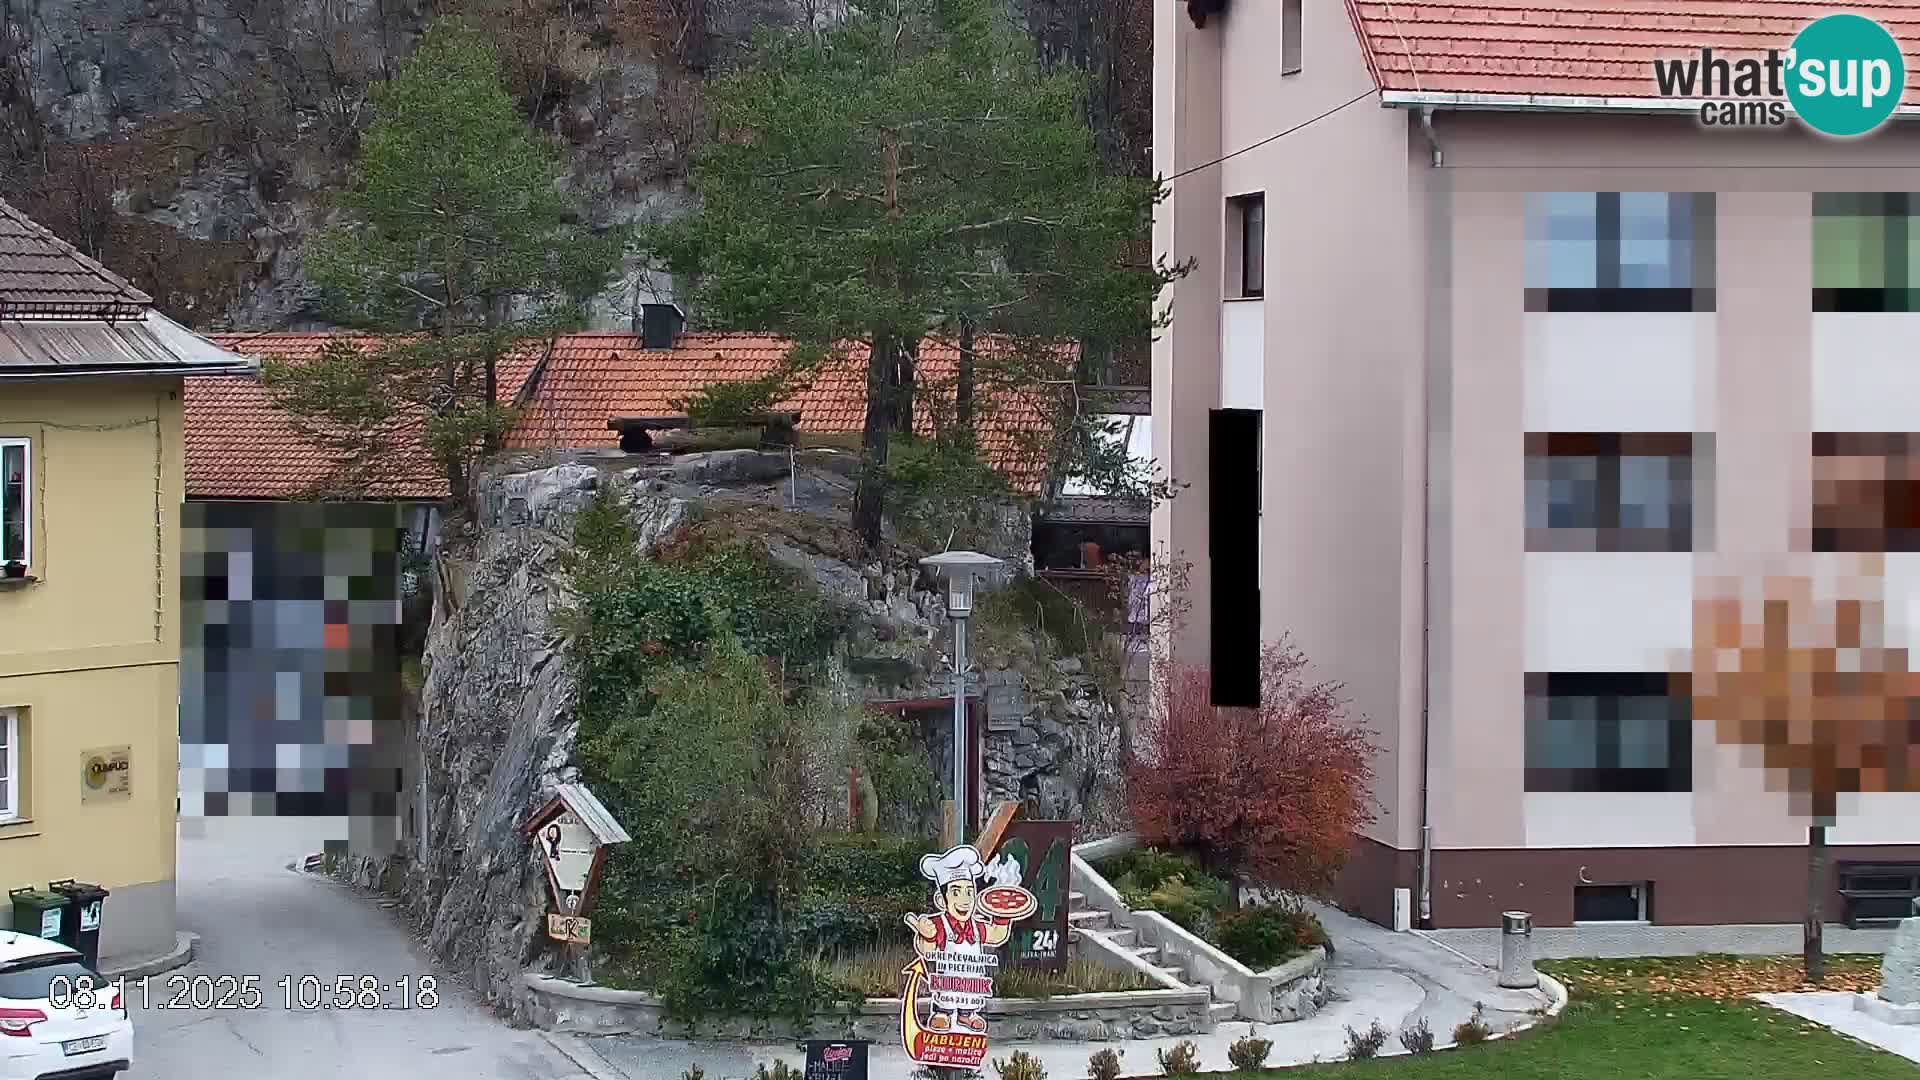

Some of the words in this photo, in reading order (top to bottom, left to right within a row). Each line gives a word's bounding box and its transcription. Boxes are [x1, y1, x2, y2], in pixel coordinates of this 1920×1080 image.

[925, 952, 997, 964] OKREPČEVALNICA
[937, 962, 947, 971] IN
[948, 963, 985, 973] PICERIJA
[923, 1033, 987, 1048] VABLJENI
